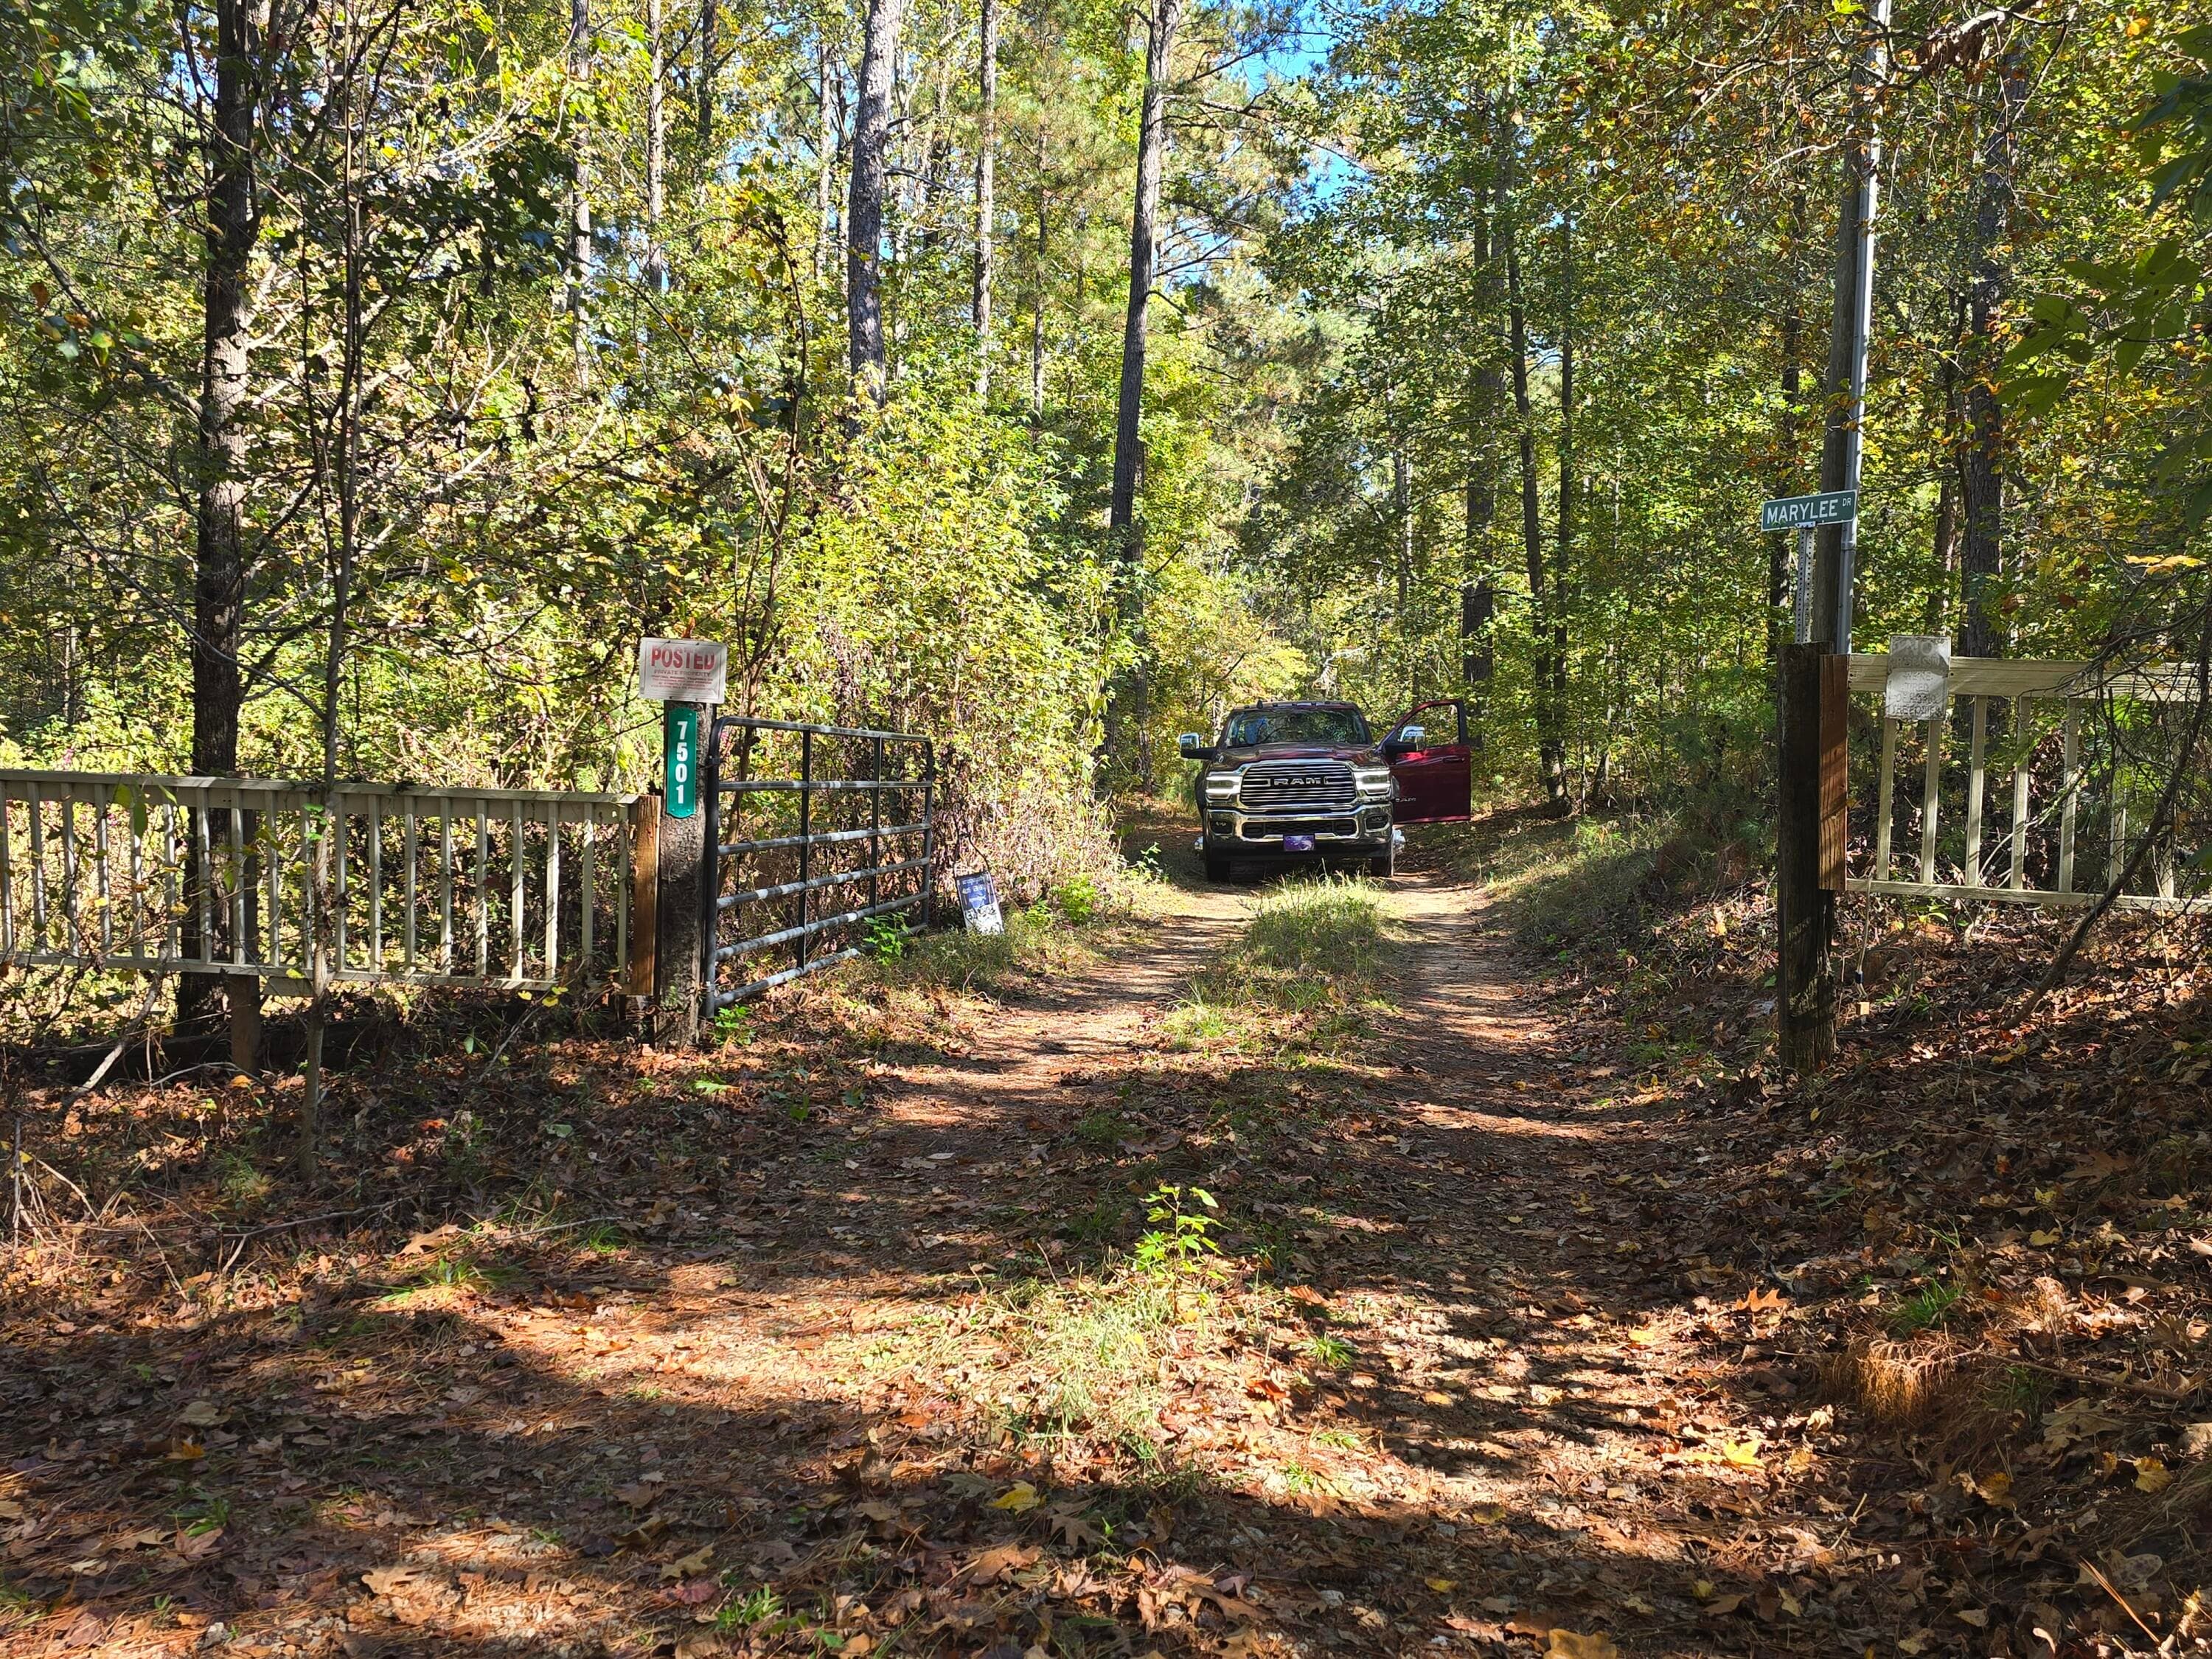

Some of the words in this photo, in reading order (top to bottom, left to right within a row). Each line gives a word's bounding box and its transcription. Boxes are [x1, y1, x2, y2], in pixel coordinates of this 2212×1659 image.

[1767, 499, 1838, 524] MARYLEE
[1843, 498, 1851, 507] DR
[650, 645, 715, 670] POSTED
[675, 720, 689, 804] 7501
[1273, 777, 1321, 785] RAM
